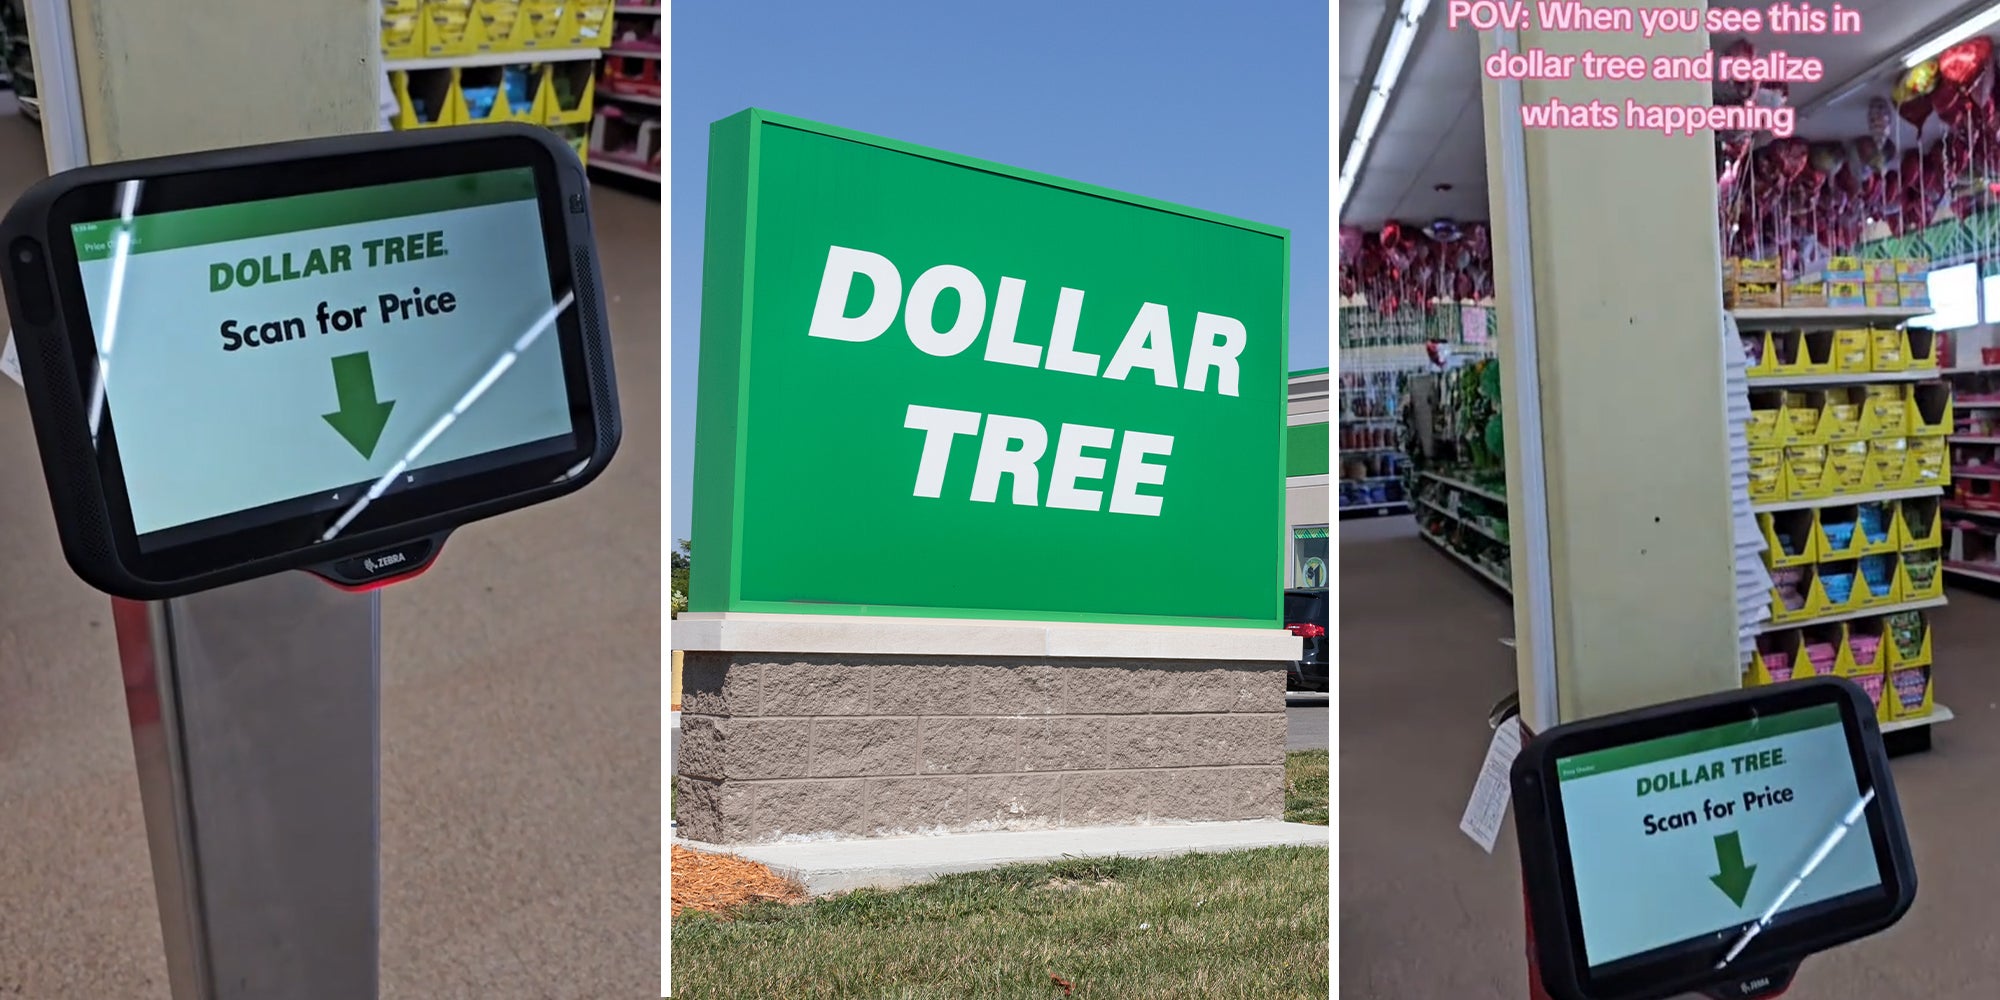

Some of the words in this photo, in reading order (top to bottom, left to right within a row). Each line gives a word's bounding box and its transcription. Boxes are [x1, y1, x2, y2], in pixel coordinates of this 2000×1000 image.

[209, 244, 352, 292] DOLLAR
[220, 317, 307, 352] Scan
[316, 301, 367, 335] for
[378, 286, 457, 324] Price
[808, 245, 1247, 398] DOLLAR
[903, 404, 1175, 517] TREE
[377, 552, 406, 568] ZEBRA
[1636, 761, 1725, 797] DOLLAR
[1643, 810, 1698, 836] Scan
[1703, 799, 1736, 821] for
[1743, 786, 1794, 811] Price
